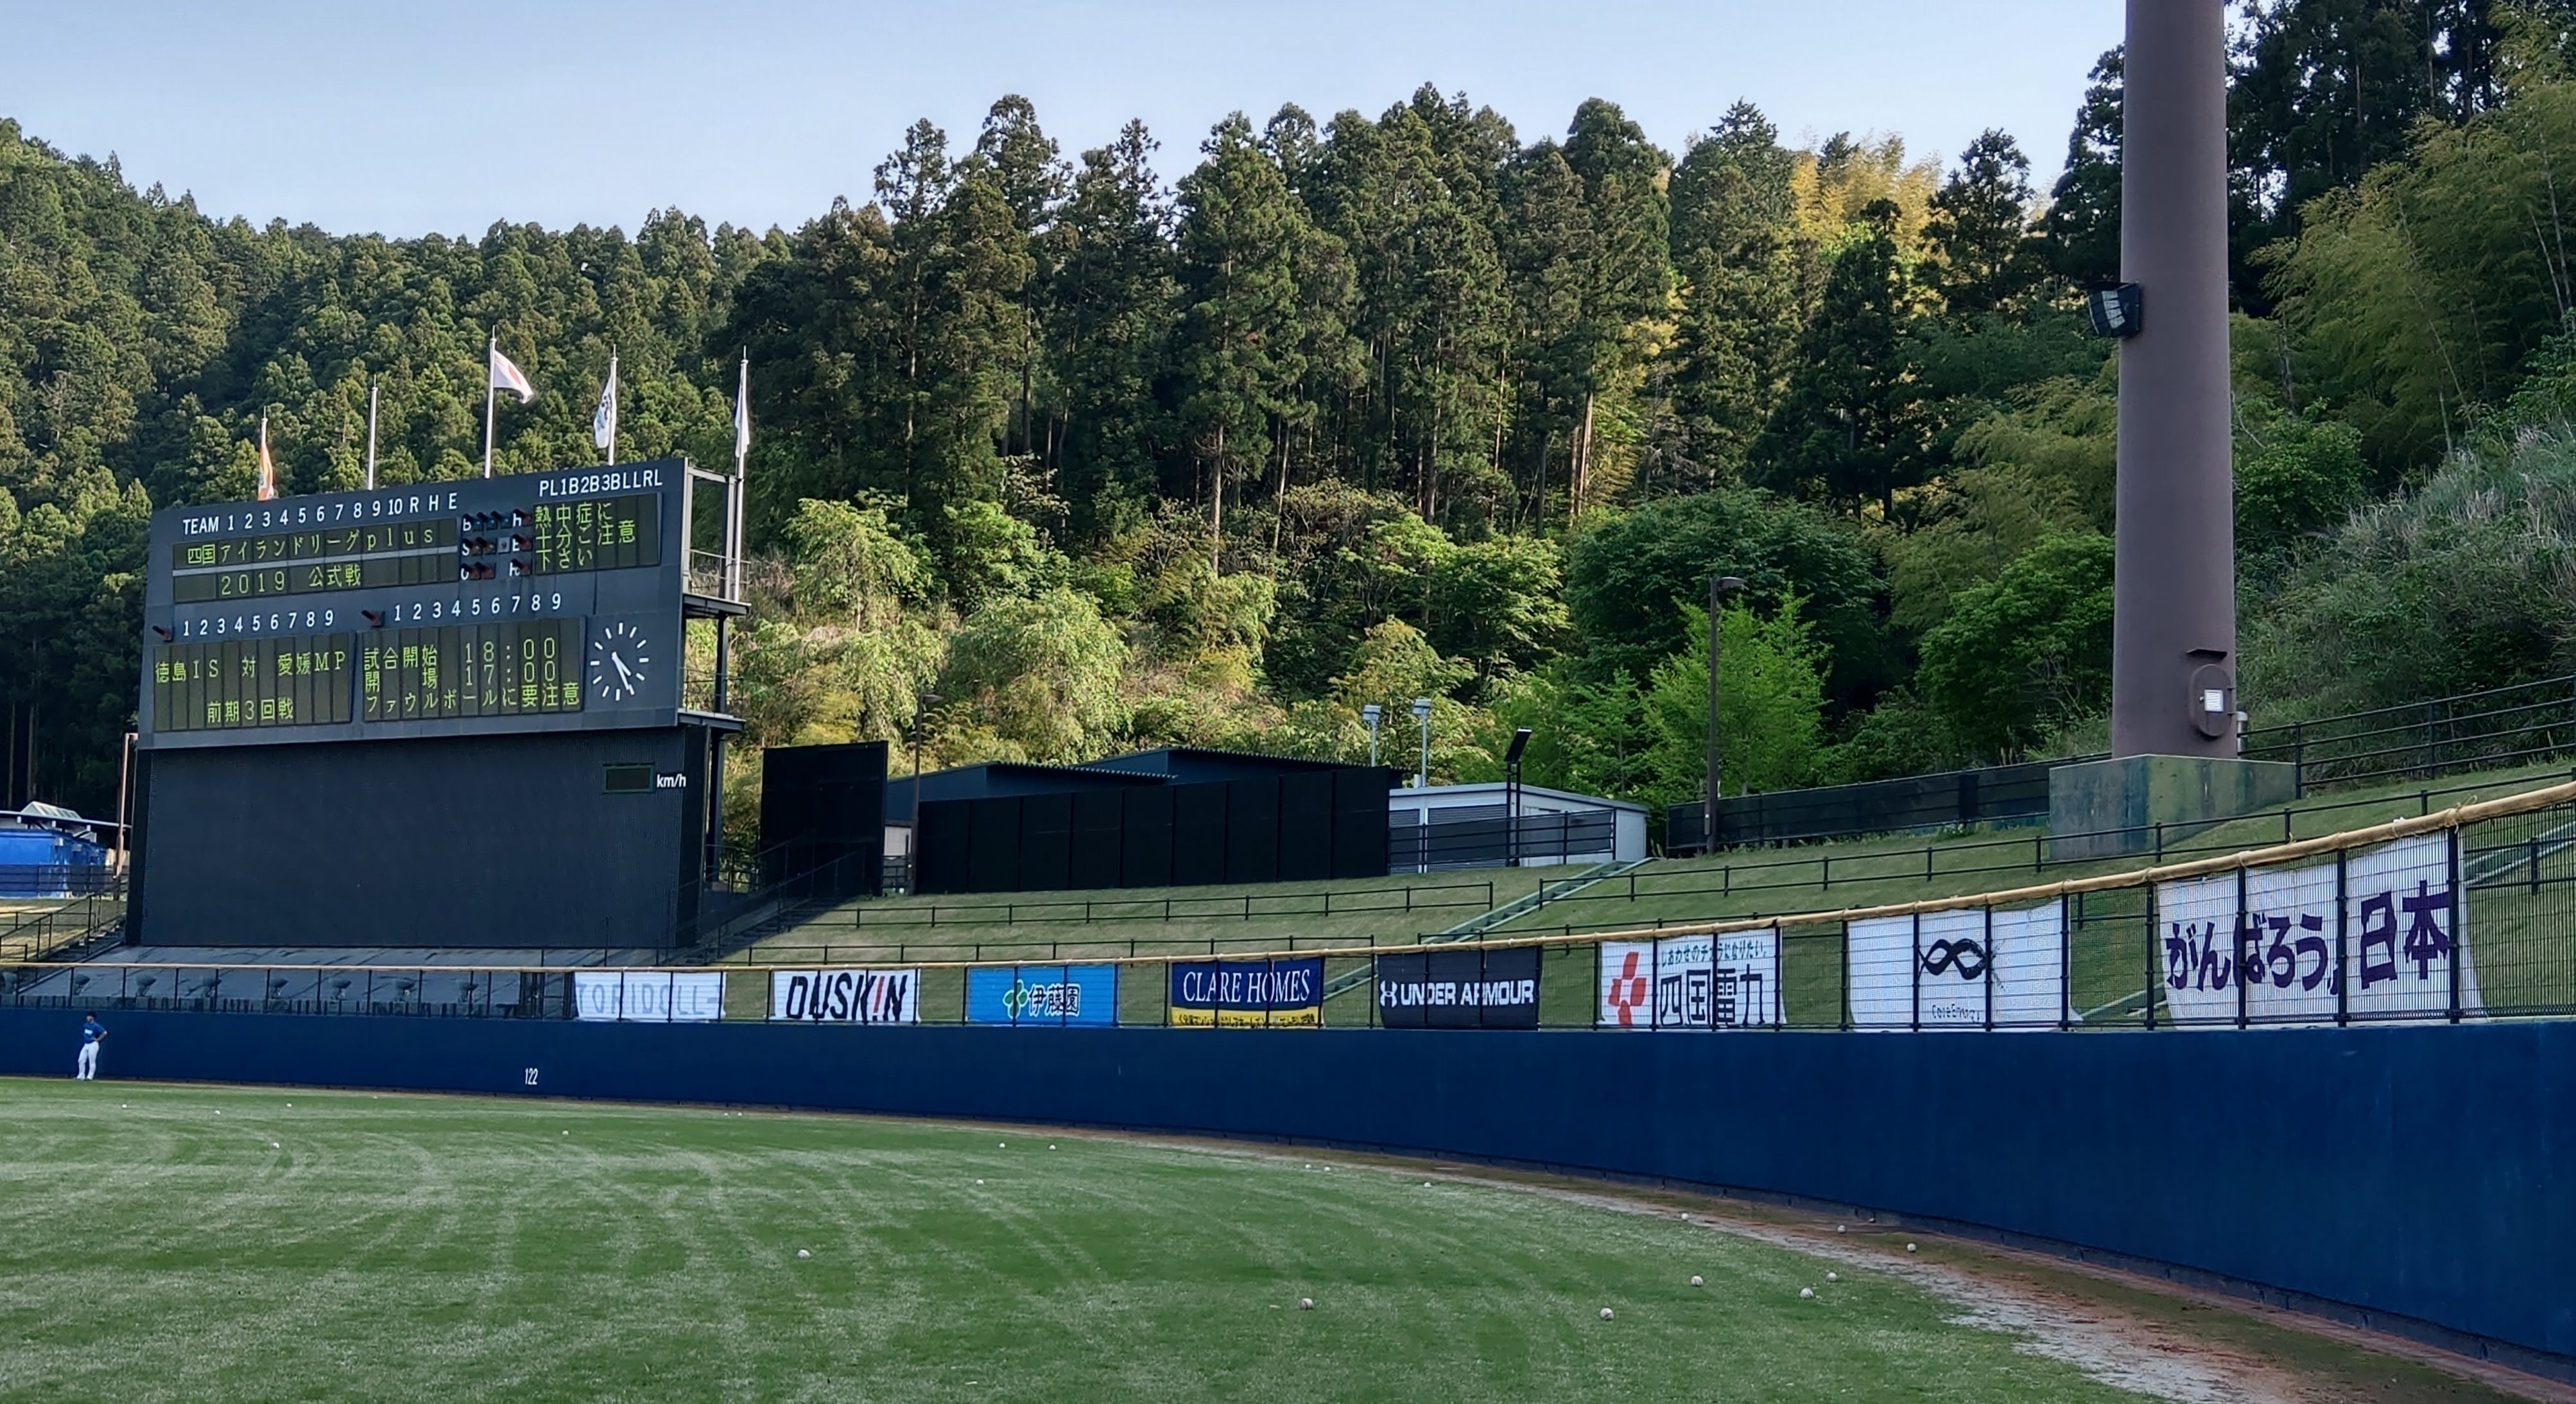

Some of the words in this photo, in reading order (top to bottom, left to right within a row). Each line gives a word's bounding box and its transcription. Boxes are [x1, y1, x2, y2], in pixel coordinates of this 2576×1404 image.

[182, 516, 220, 535] TEAM
[228, 514, 234, 531] 1
[245, 513, 253, 529] 2
[262, 511, 271, 527] 3
[279, 509, 289, 525] 4
[298, 507, 306, 524] 5
[316, 505, 325, 522] 6
[335, 503, 343, 521] 7
[353, 502, 362, 519] 8
[372, 500, 381, 517] 9
[388, 498, 403, 516] 10
[410, 496, 419, 514] R
[428, 494, 439, 512] H
[449, 492, 457, 510] E
[535, 502, 612, 529] 熱中症に
[187, 527, 433, 565] 四国アイランドリーグplus
[535, 519, 635, 550] 十分ご注意
[535, 548, 592, 572] 下さい
[221, 571, 285, 595] 2019
[308, 564, 361, 587] 公式戦
[183, 620, 189, 636] 1
[200, 619, 208, 636] 2
[217, 618, 225, 634] 3
[234, 616, 243, 632] 4
[252, 614, 261, 632] 5
[270, 614, 279, 630] 6
[288, 612, 297, 629] 7
[306, 611, 315, 627] 8
[325, 609, 334, 626] 9
[394, 604, 401, 621] 1
[413, 603, 422, 620] 2
[432, 602, 442, 618] 3
[451, 600, 461, 617] 4
[472, 598, 480, 616] 5
[491, 597, 500, 614] 6
[512, 595, 521, 613] 7
[531, 594, 540, 611] 8
[552, 593, 561, 610] 9
[155, 659, 219, 683] 徳島IS
[241, 655, 256, 678] 対
[277, 651, 346, 677] 愛媛MP
[363, 644, 438, 672] 試合開始
[466, 637, 555, 664] 18:00
[466, 661, 555, 686] 17:00
[207, 697, 293, 724] 前期3回戦
[367, 680, 580, 713] ファウルボールに要注意
[656, 773, 687, 788] km/h
[1028, 983, 1081, 1018] 伊藤園
[1183, 971, 1242, 1003] CLARE
[1247, 968, 1311, 1003] HOMES
[1401, 982, 1457, 1006] UNDER
[1660, 963, 1765, 1027] 四国電力
[524, 1067, 539, 1086] 122
